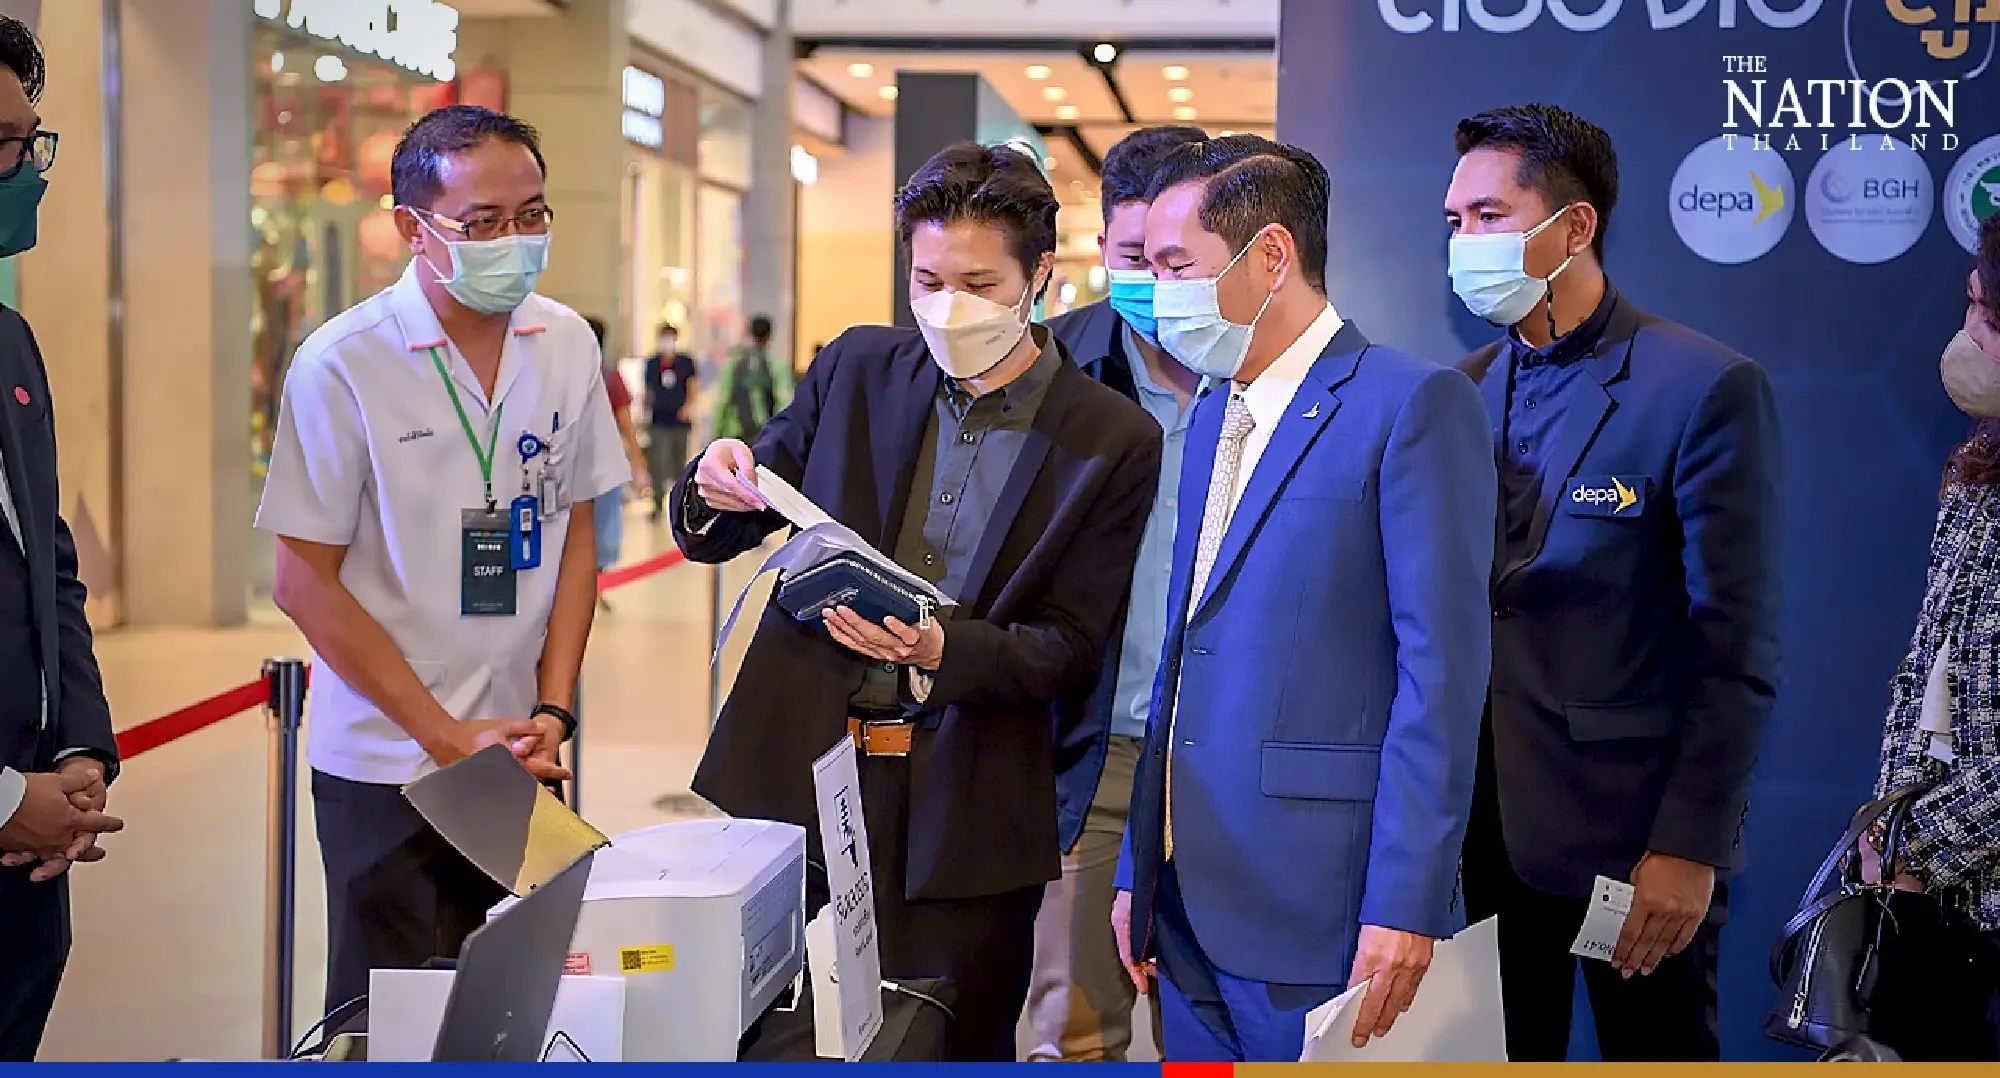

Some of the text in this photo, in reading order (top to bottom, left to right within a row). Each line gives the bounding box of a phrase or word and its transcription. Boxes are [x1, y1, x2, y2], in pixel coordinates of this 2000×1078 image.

[1863, 178, 1919, 199] BGH
[1678, 185, 1753, 217] depa
[1572, 484, 1618, 505] depa
[474, 566, 504, 576] STAFF
